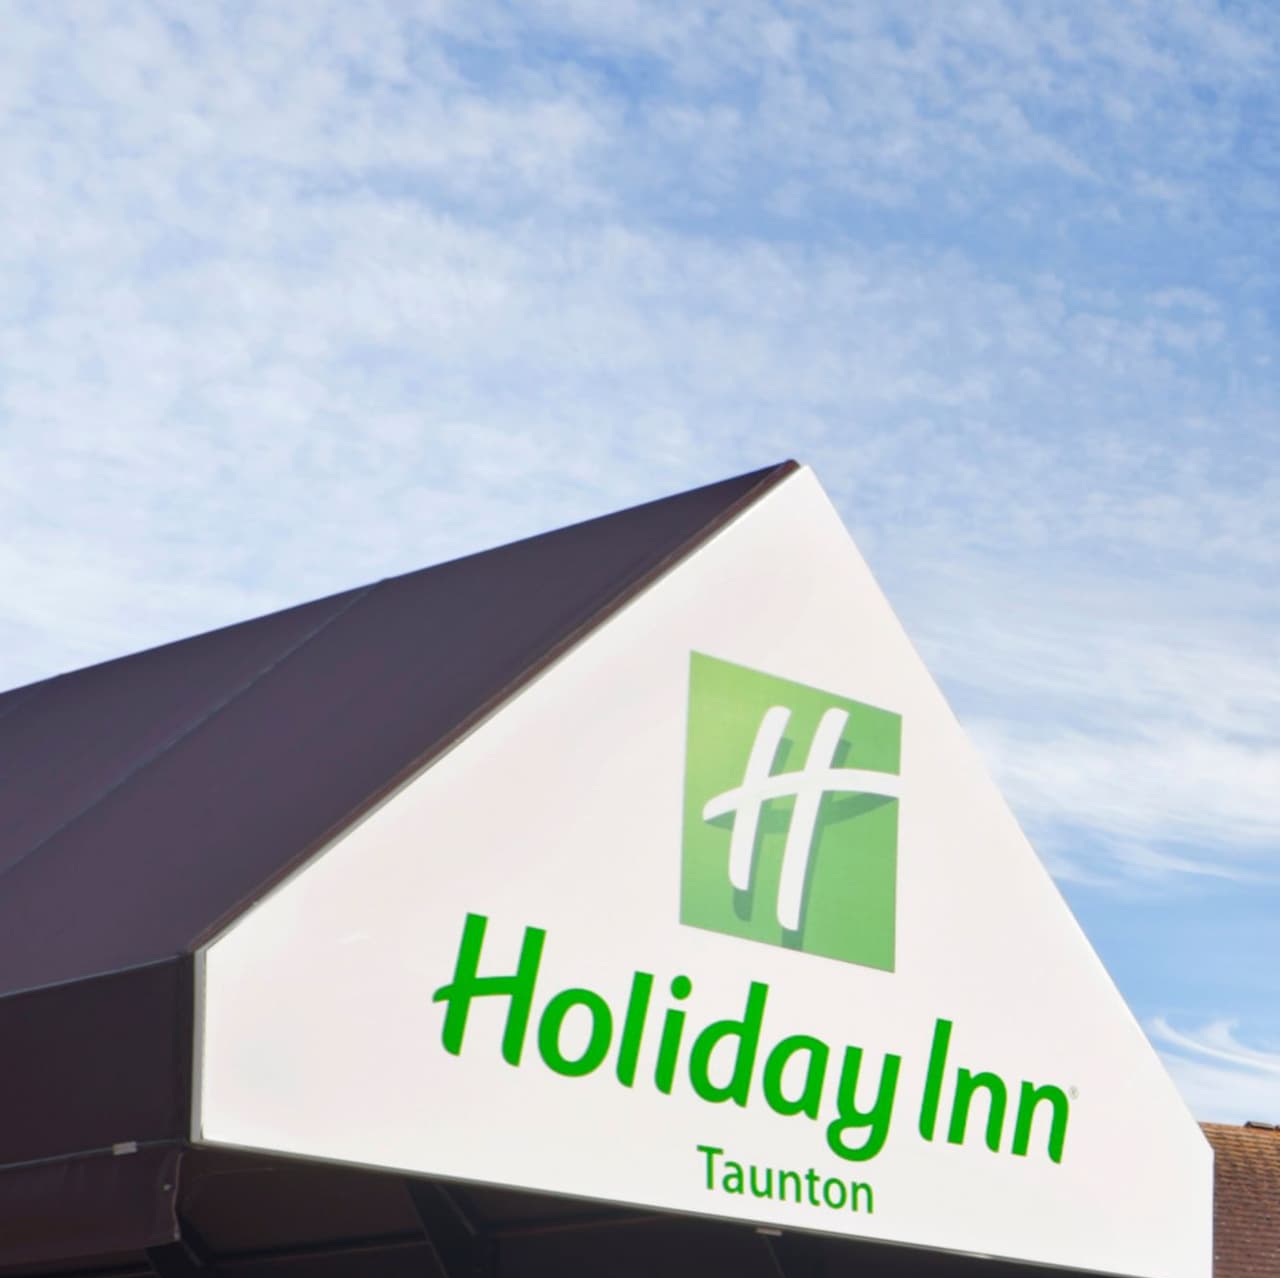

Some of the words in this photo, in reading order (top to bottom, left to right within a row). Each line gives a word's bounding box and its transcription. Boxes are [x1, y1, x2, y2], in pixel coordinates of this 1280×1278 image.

[432, 911, 902, 1163] Holiday
[918, 1017, 1071, 1165] Inn
[696, 1144, 875, 1214] Taunton
